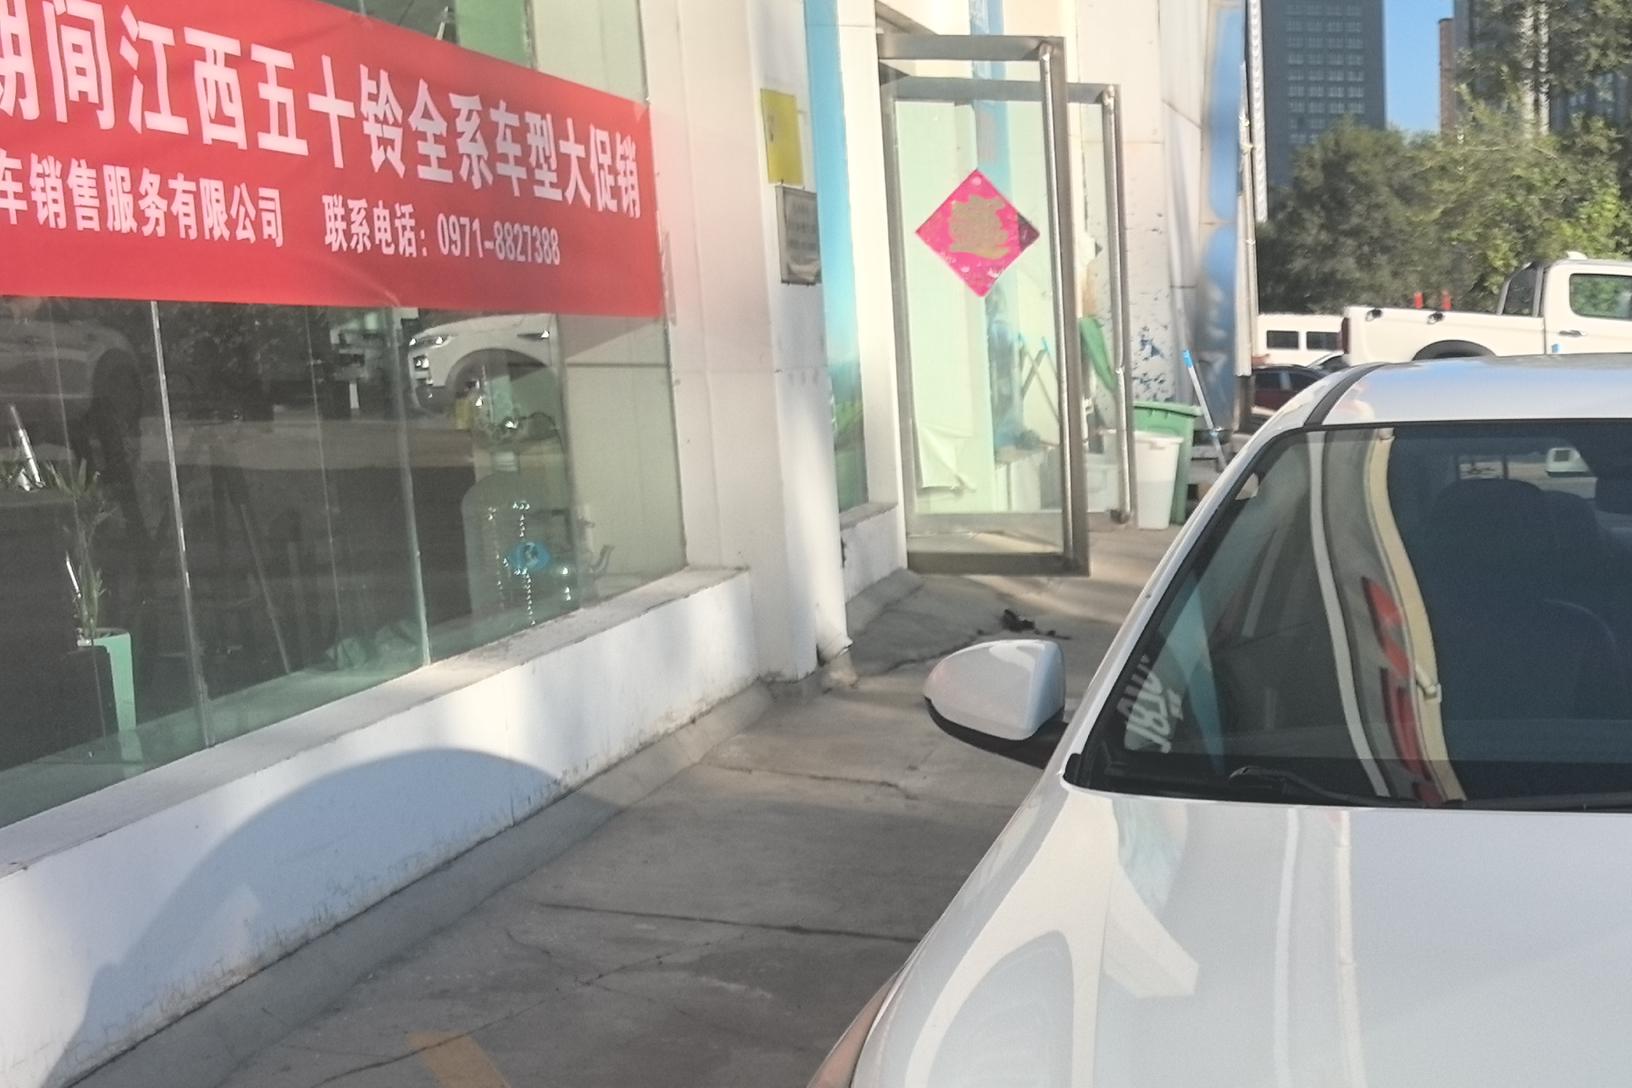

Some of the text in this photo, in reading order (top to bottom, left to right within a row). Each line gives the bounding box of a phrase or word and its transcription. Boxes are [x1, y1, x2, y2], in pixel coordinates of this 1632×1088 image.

[0, 148, 284, 248] 车销售服务有限公司
